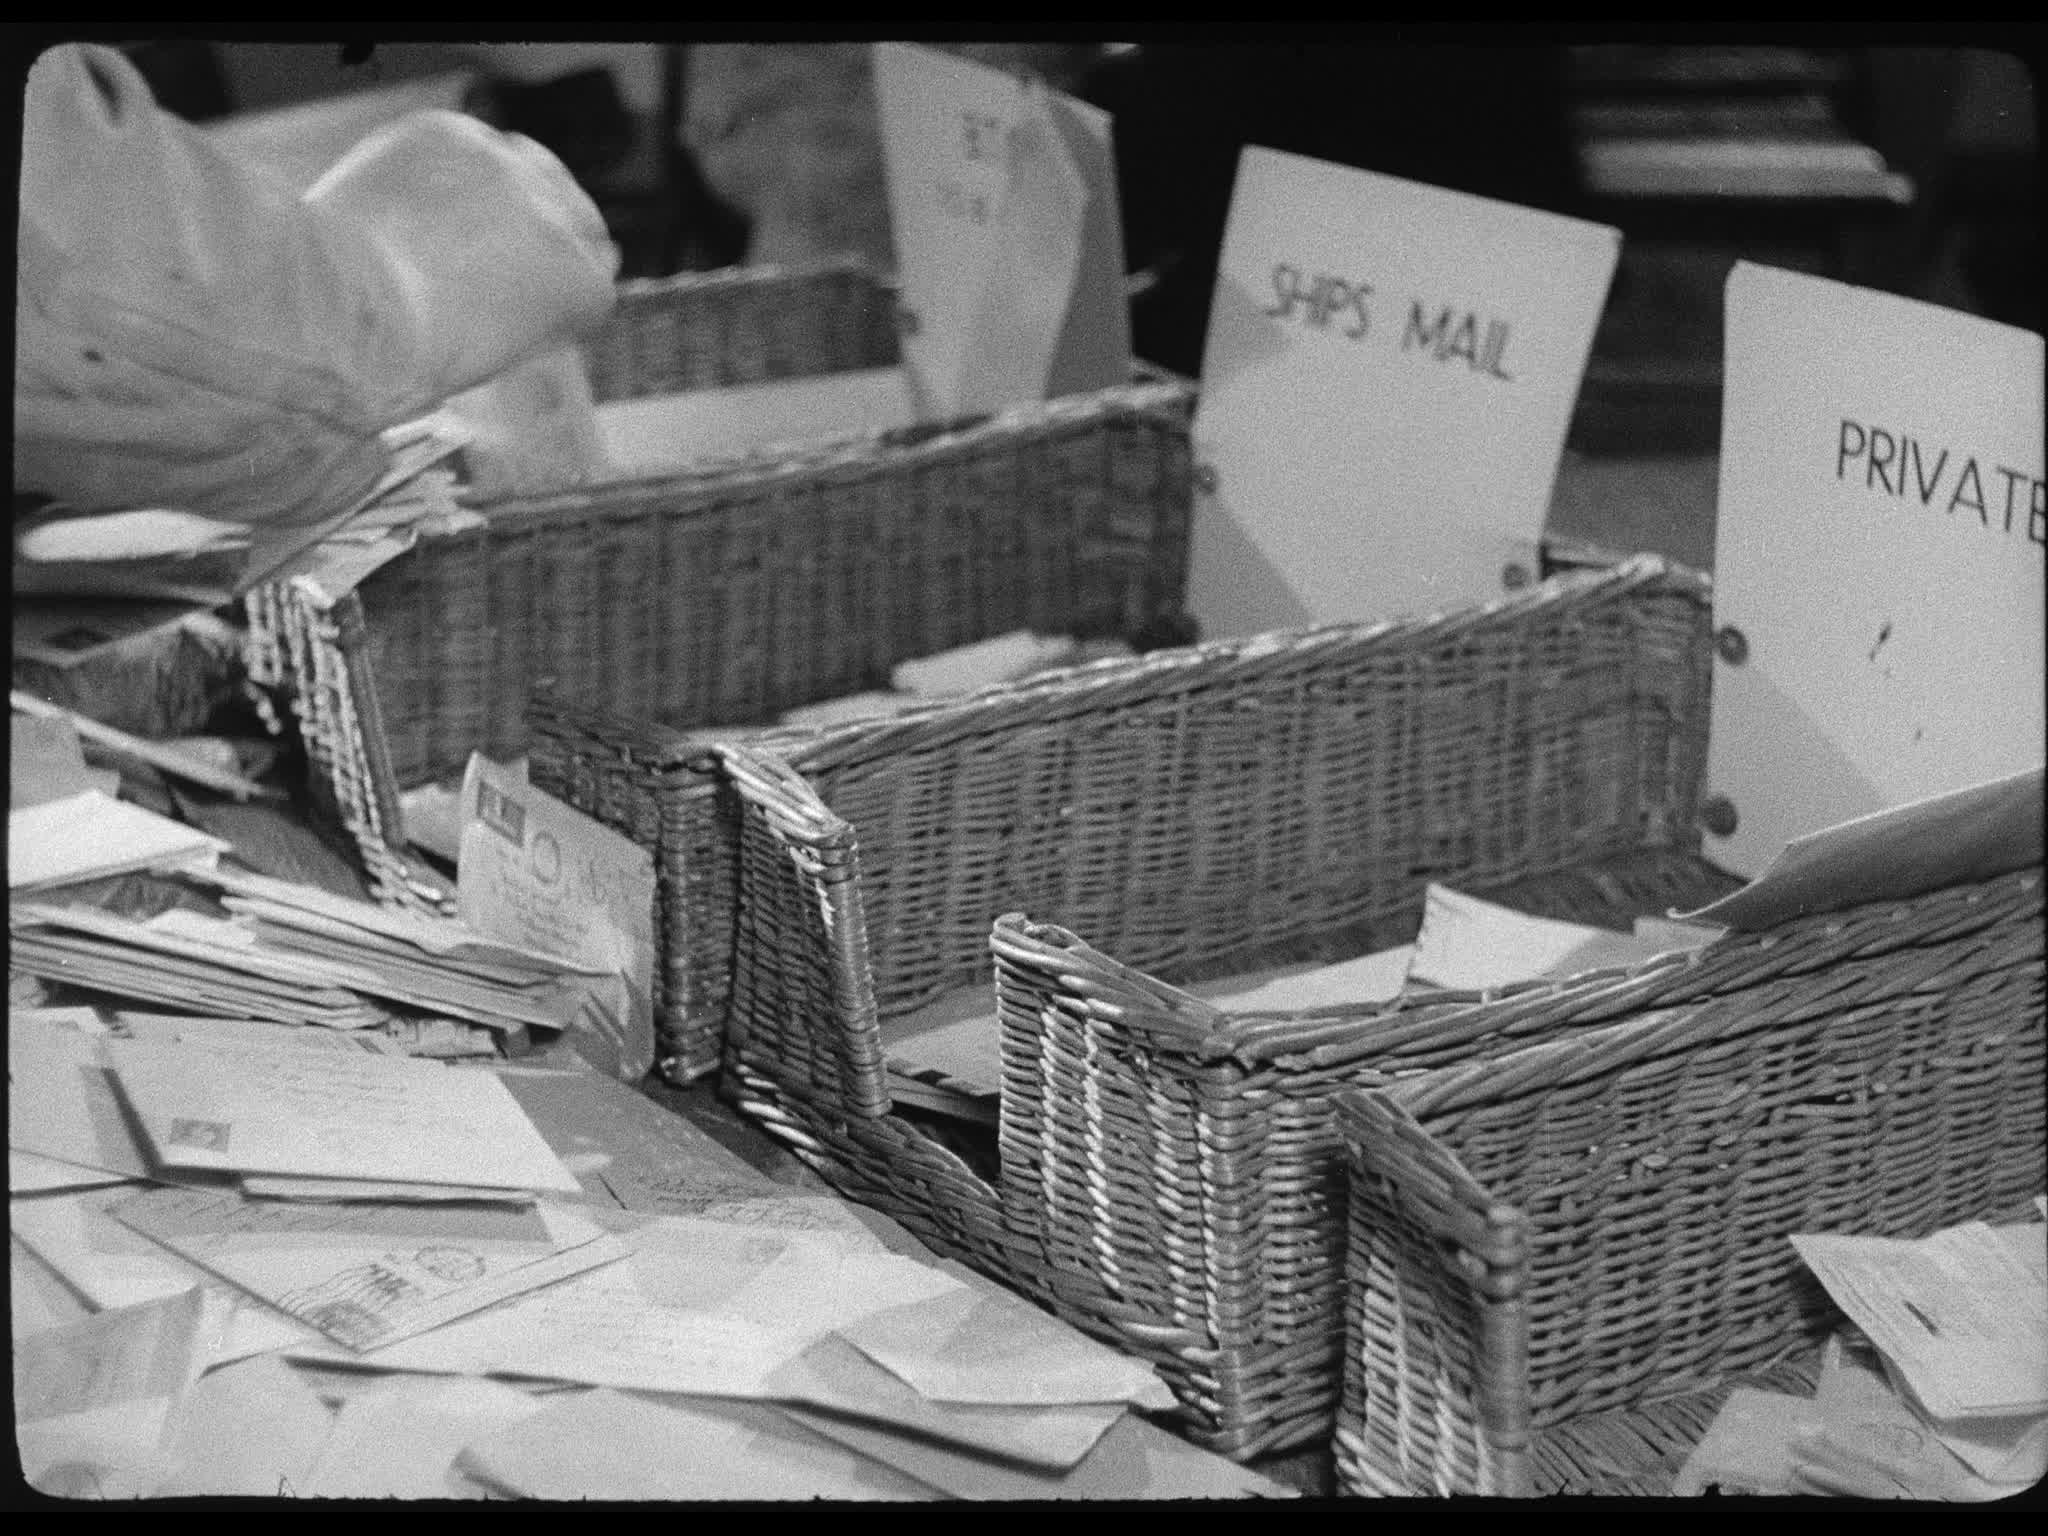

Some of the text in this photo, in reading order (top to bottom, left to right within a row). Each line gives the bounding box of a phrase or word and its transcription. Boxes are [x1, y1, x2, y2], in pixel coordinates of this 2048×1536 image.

[1266, 263, 1513, 380] SHIPS MAIL
[1837, 419, 2046, 546] PRIVATE
